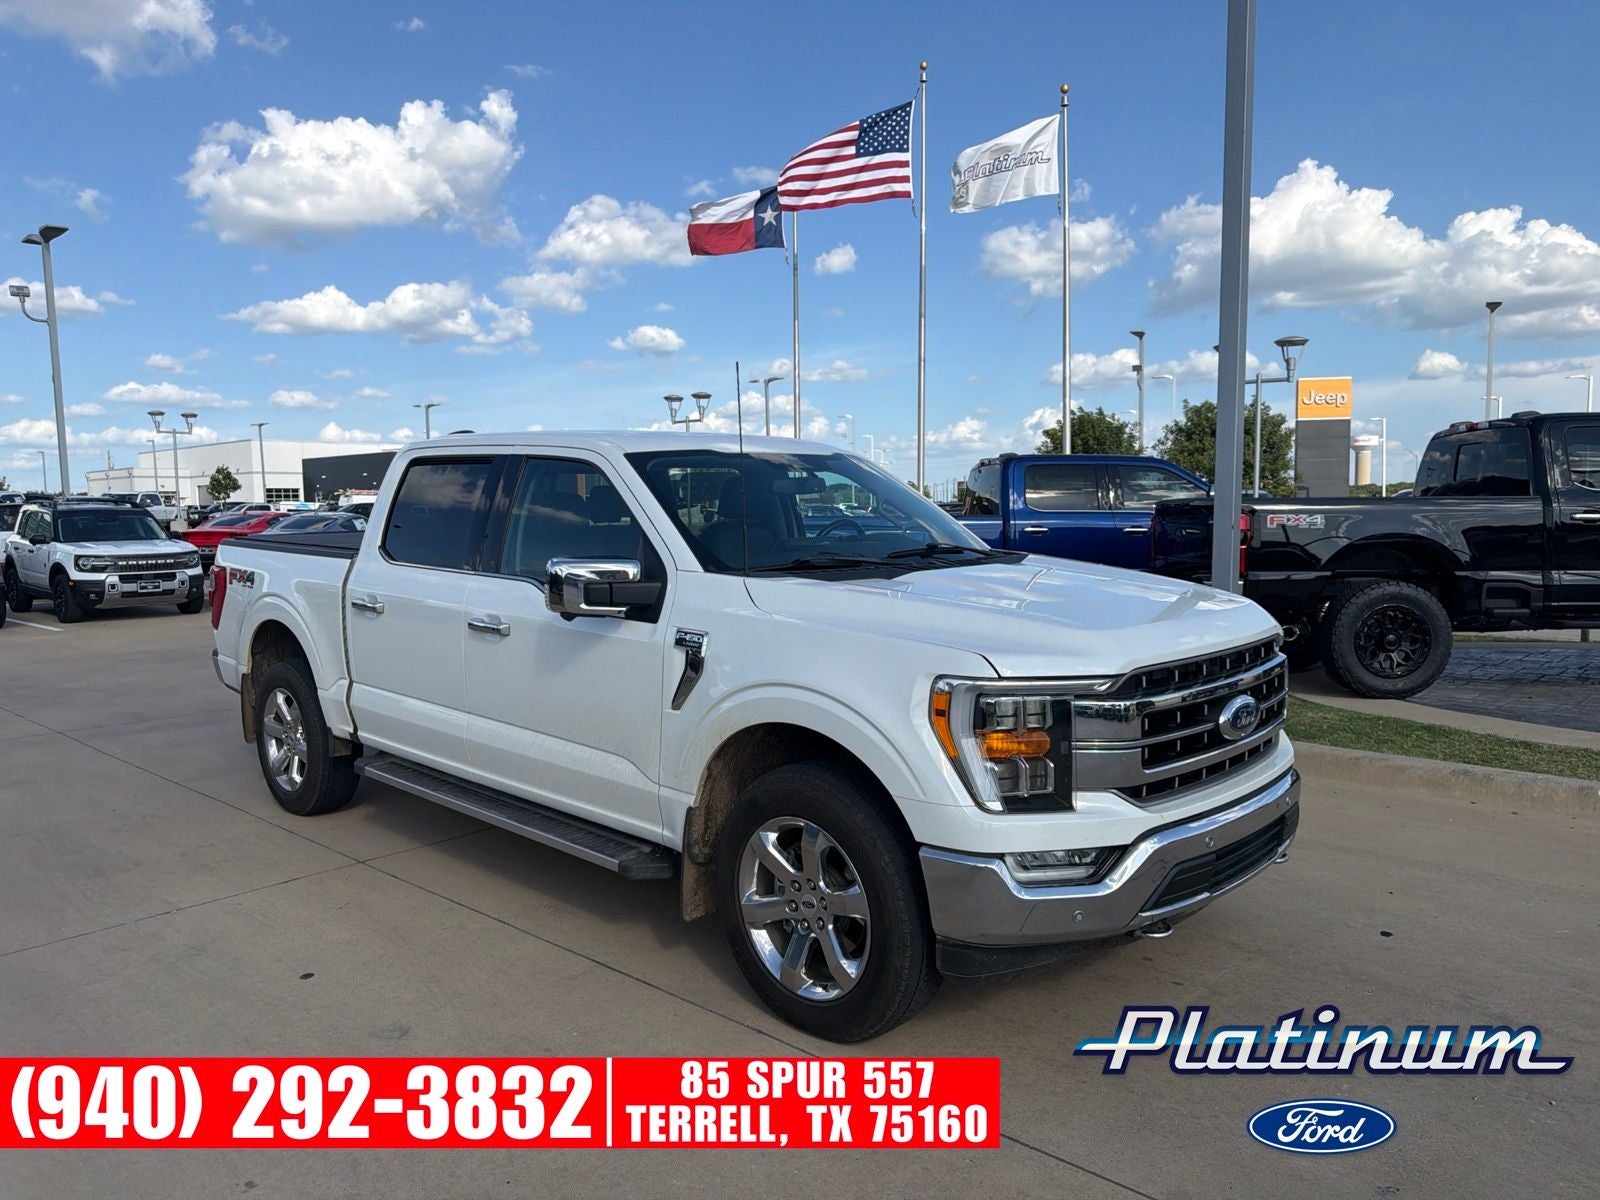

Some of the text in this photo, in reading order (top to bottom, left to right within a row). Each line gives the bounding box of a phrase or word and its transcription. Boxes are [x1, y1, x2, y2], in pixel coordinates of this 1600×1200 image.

[1302, 388, 1348, 408] Jeep
[1266, 513, 1325, 528] FX4
[229, 567, 255, 585] FX4
